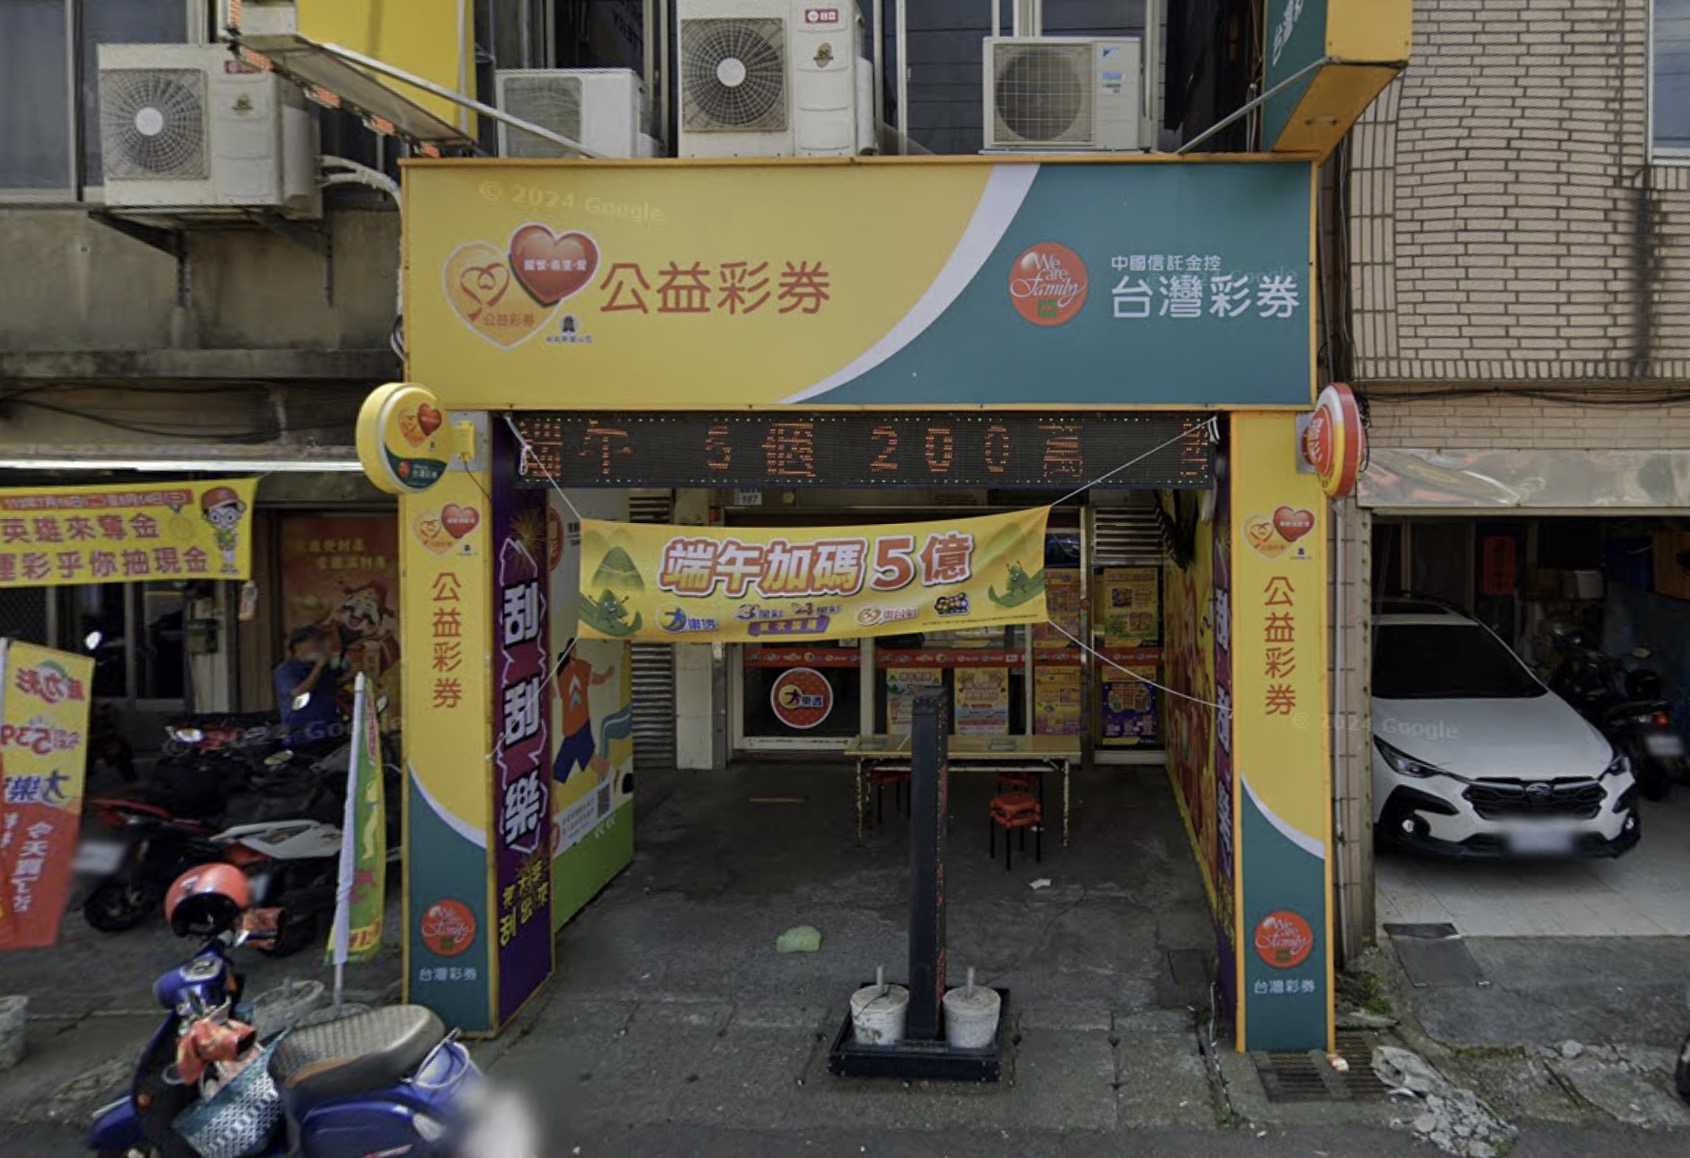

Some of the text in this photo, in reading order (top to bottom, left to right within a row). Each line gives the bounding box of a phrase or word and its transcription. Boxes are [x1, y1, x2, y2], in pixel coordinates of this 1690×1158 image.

[599, 260, 831, 316] 公益彩券
[1111, 254, 1221, 272] 中國信託金控
[1111, 274, 1301, 319] 台灣彩券
[659, 530, 974, 598] 端午加碼5億
[432, 572, 462, 709] 公益彩券
[1264, 576, 1297, 716] 公益彩券
[503, 580, 541, 847] 刮刮樂
[419, 966, 478, 983] 台灣彩券
[1253, 978, 1316, 995] 台灣彩券
